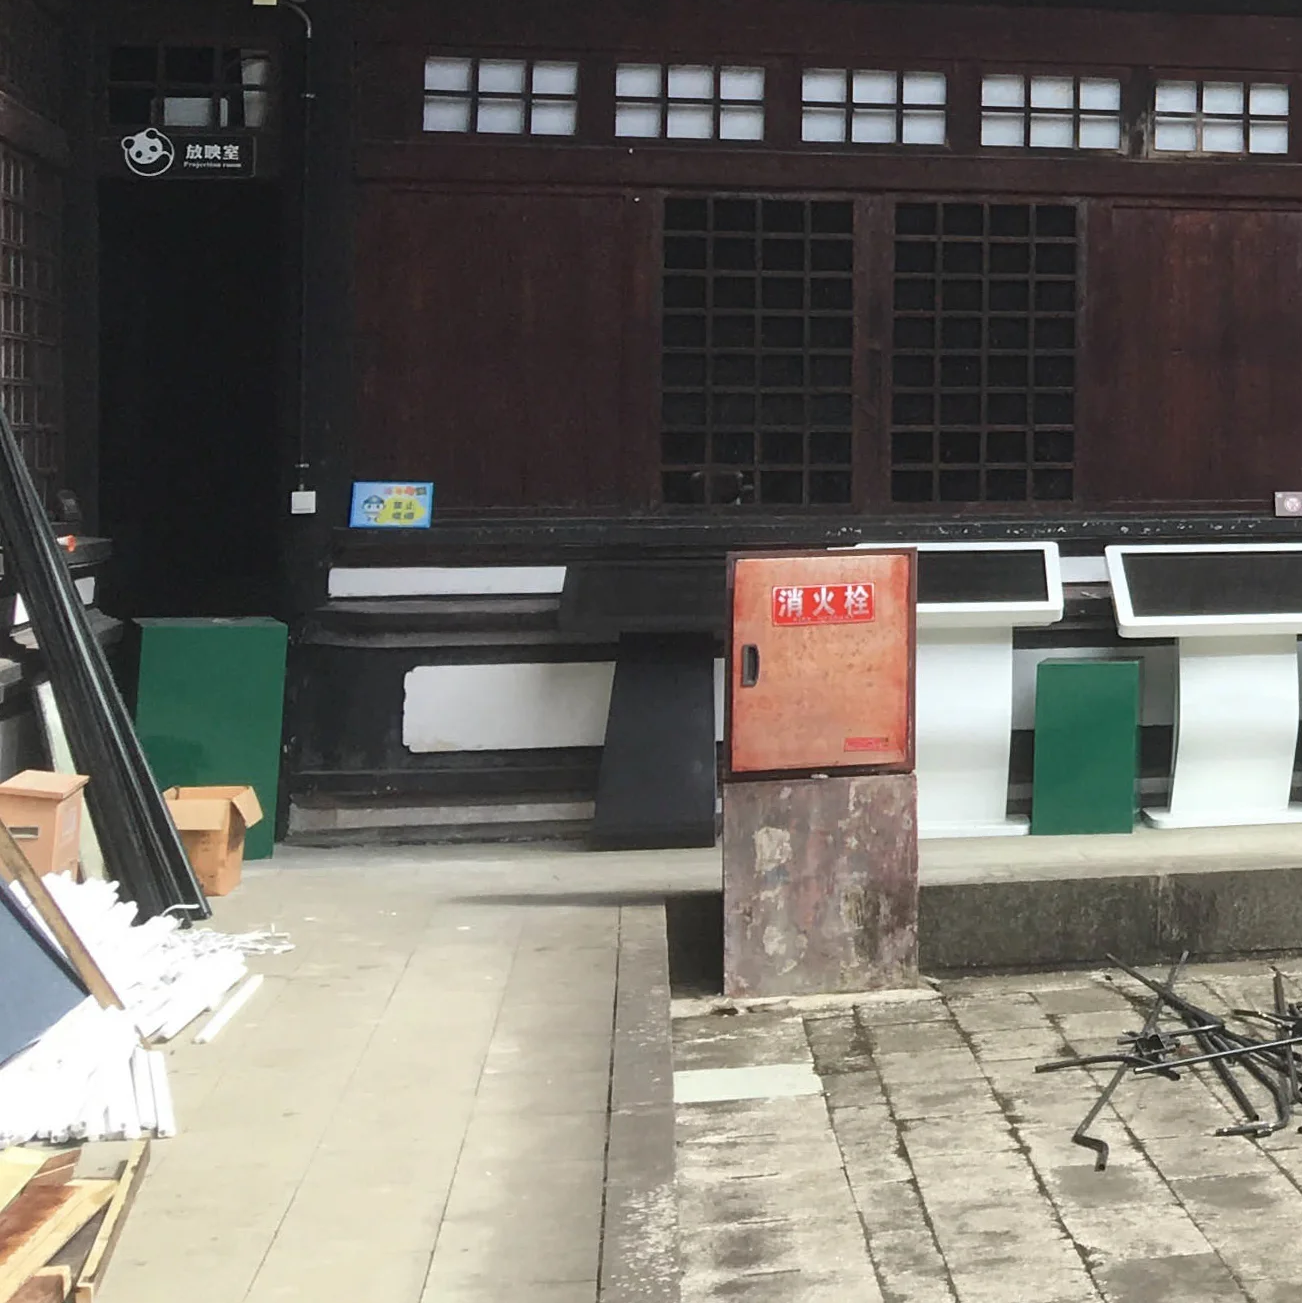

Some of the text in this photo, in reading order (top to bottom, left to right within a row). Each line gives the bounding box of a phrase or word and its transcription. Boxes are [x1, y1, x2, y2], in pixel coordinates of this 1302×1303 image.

[185, 143, 240, 161] 放映室
[777, 584, 870, 617] 消火栓
